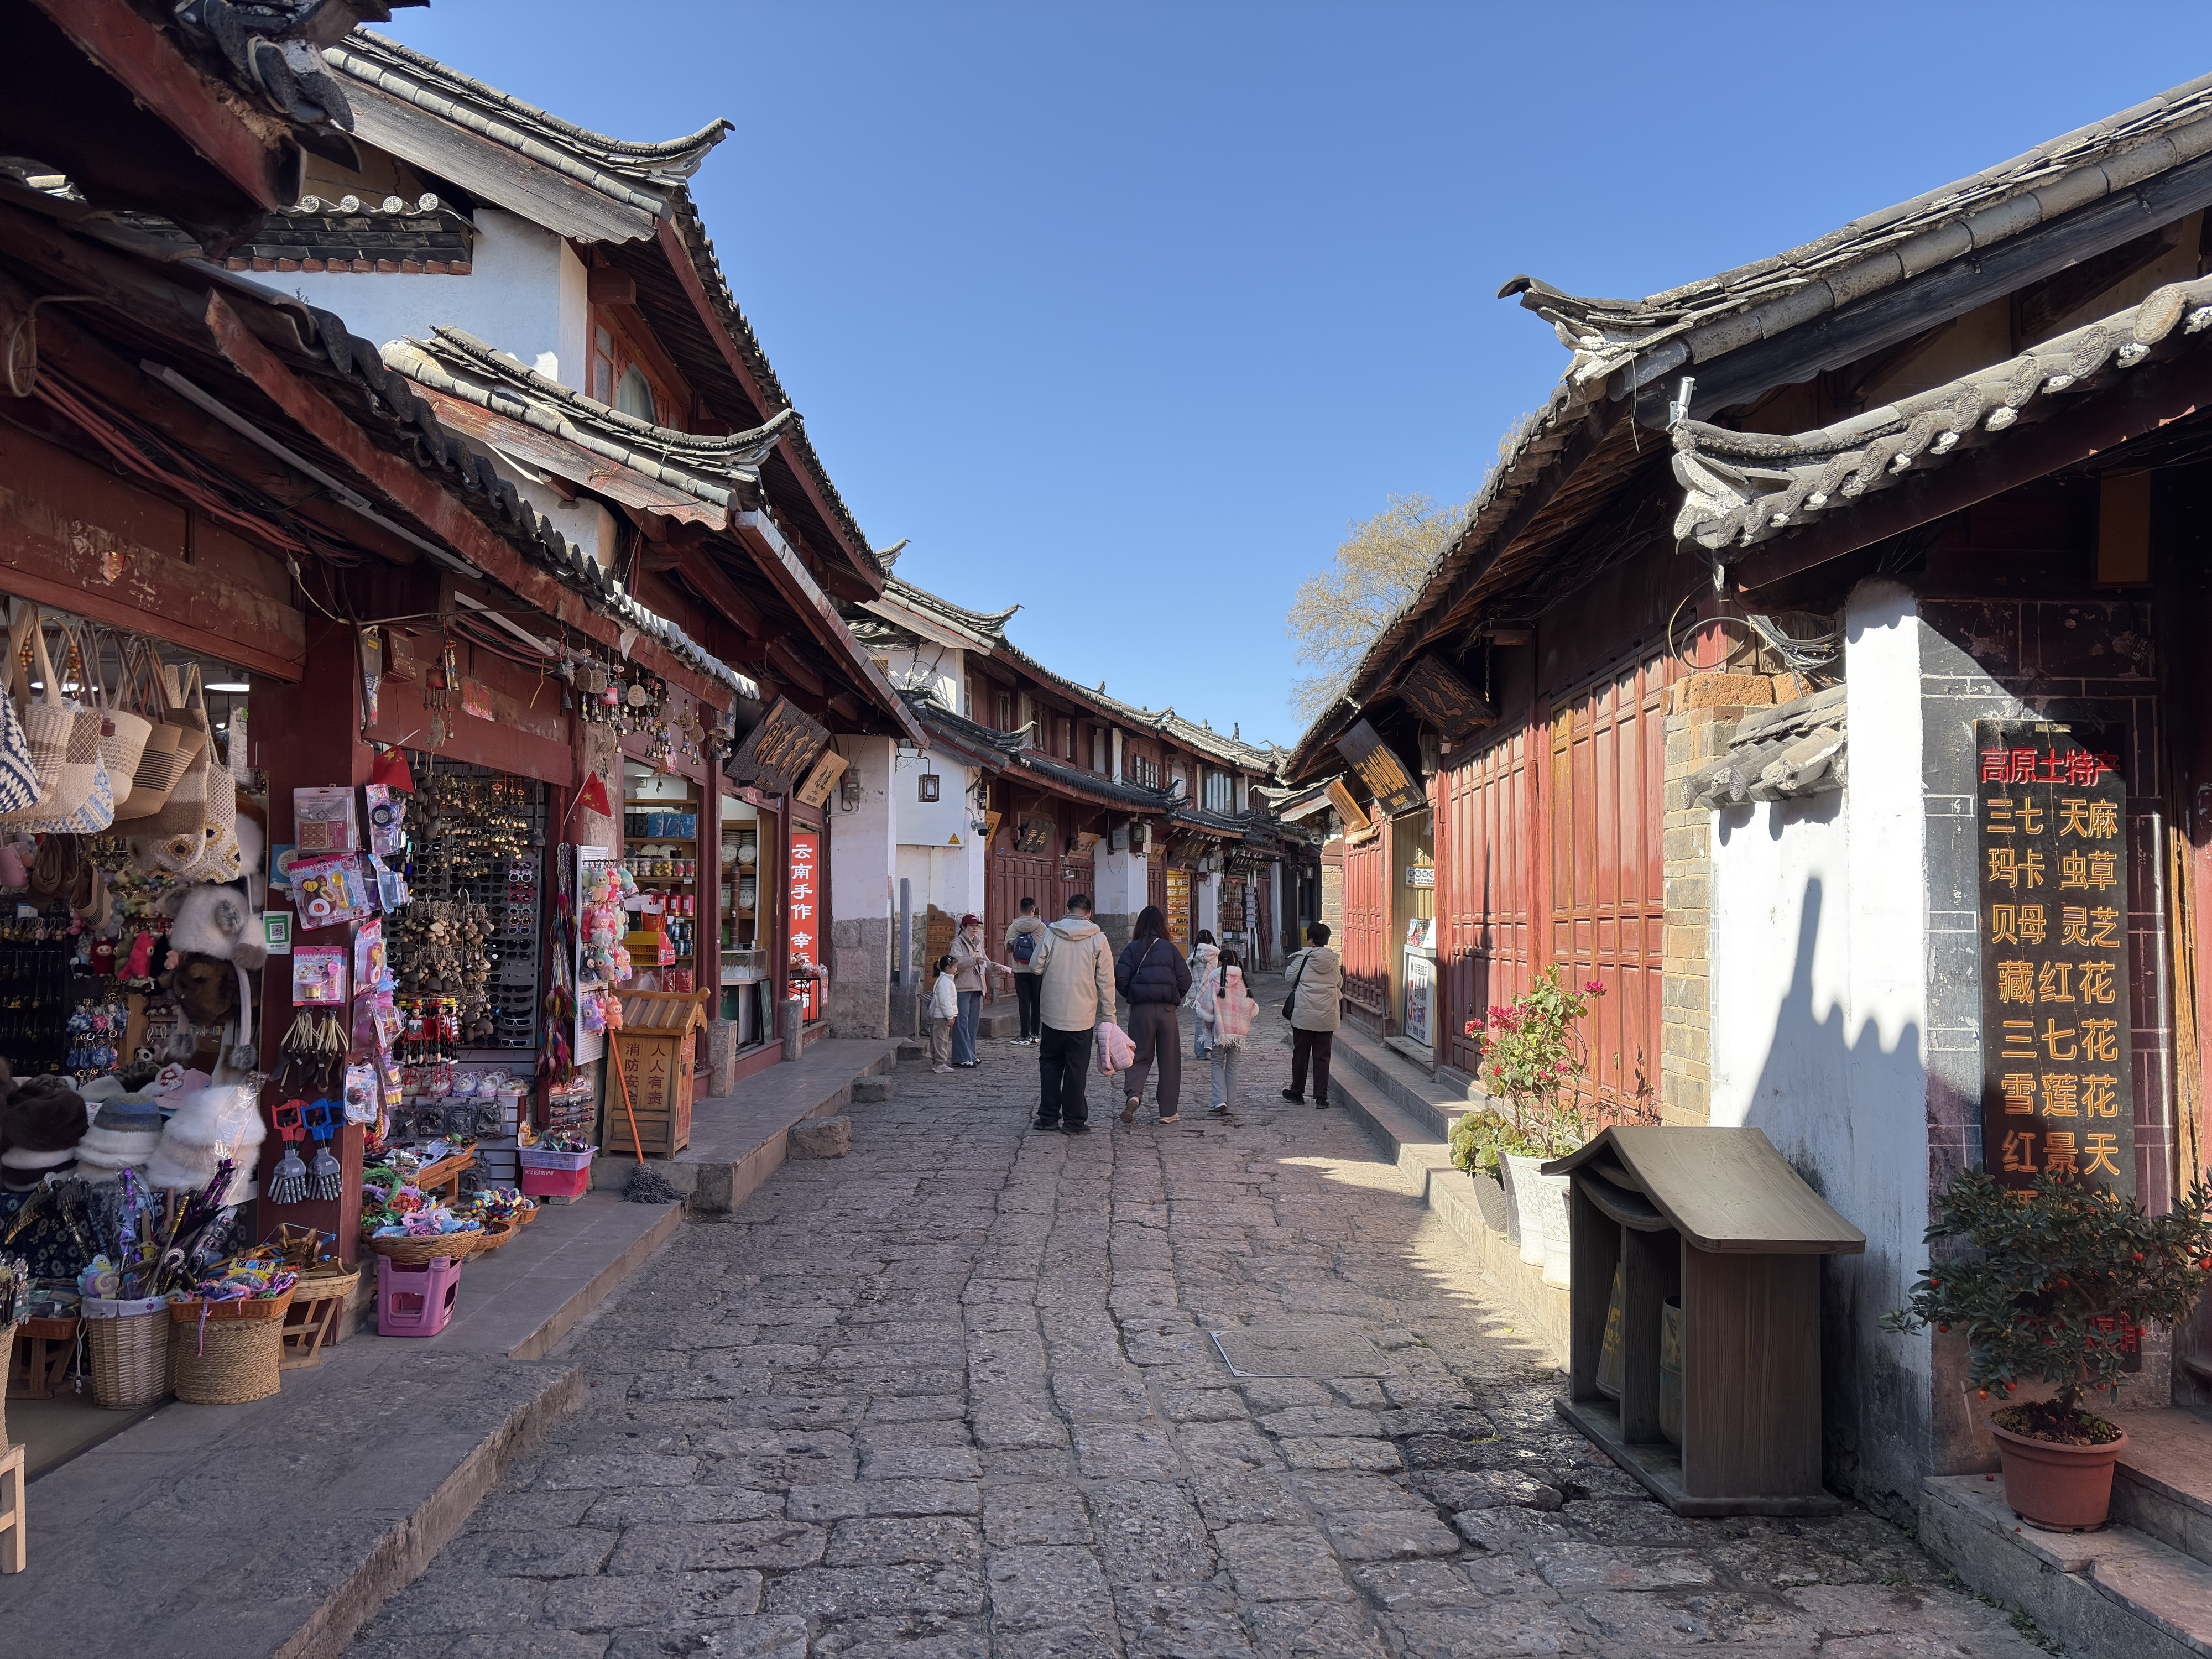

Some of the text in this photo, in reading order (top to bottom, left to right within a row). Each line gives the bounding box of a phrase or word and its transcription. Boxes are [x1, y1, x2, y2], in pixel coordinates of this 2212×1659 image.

[1980, 745, 2121, 787] 高原土特产
[1987, 797, 2118, 838] 三七 天麻
[791, 844, 813, 920] 云南手作
[1989, 848, 2117, 890] 玛卡 虫草
[1991, 904, 2120, 947] 贝母 灵芝
[1997, 961, 2116, 1004] 藏红花
[2002, 1018, 2119, 1062] 三七花
[622, 1043, 640, 1105] 消防安全
[647, 1043, 666, 1105] 人人有责
[2001, 1073, 2119, 1118] 雪莲花
[2002, 1130, 2121, 1176] 红景天
